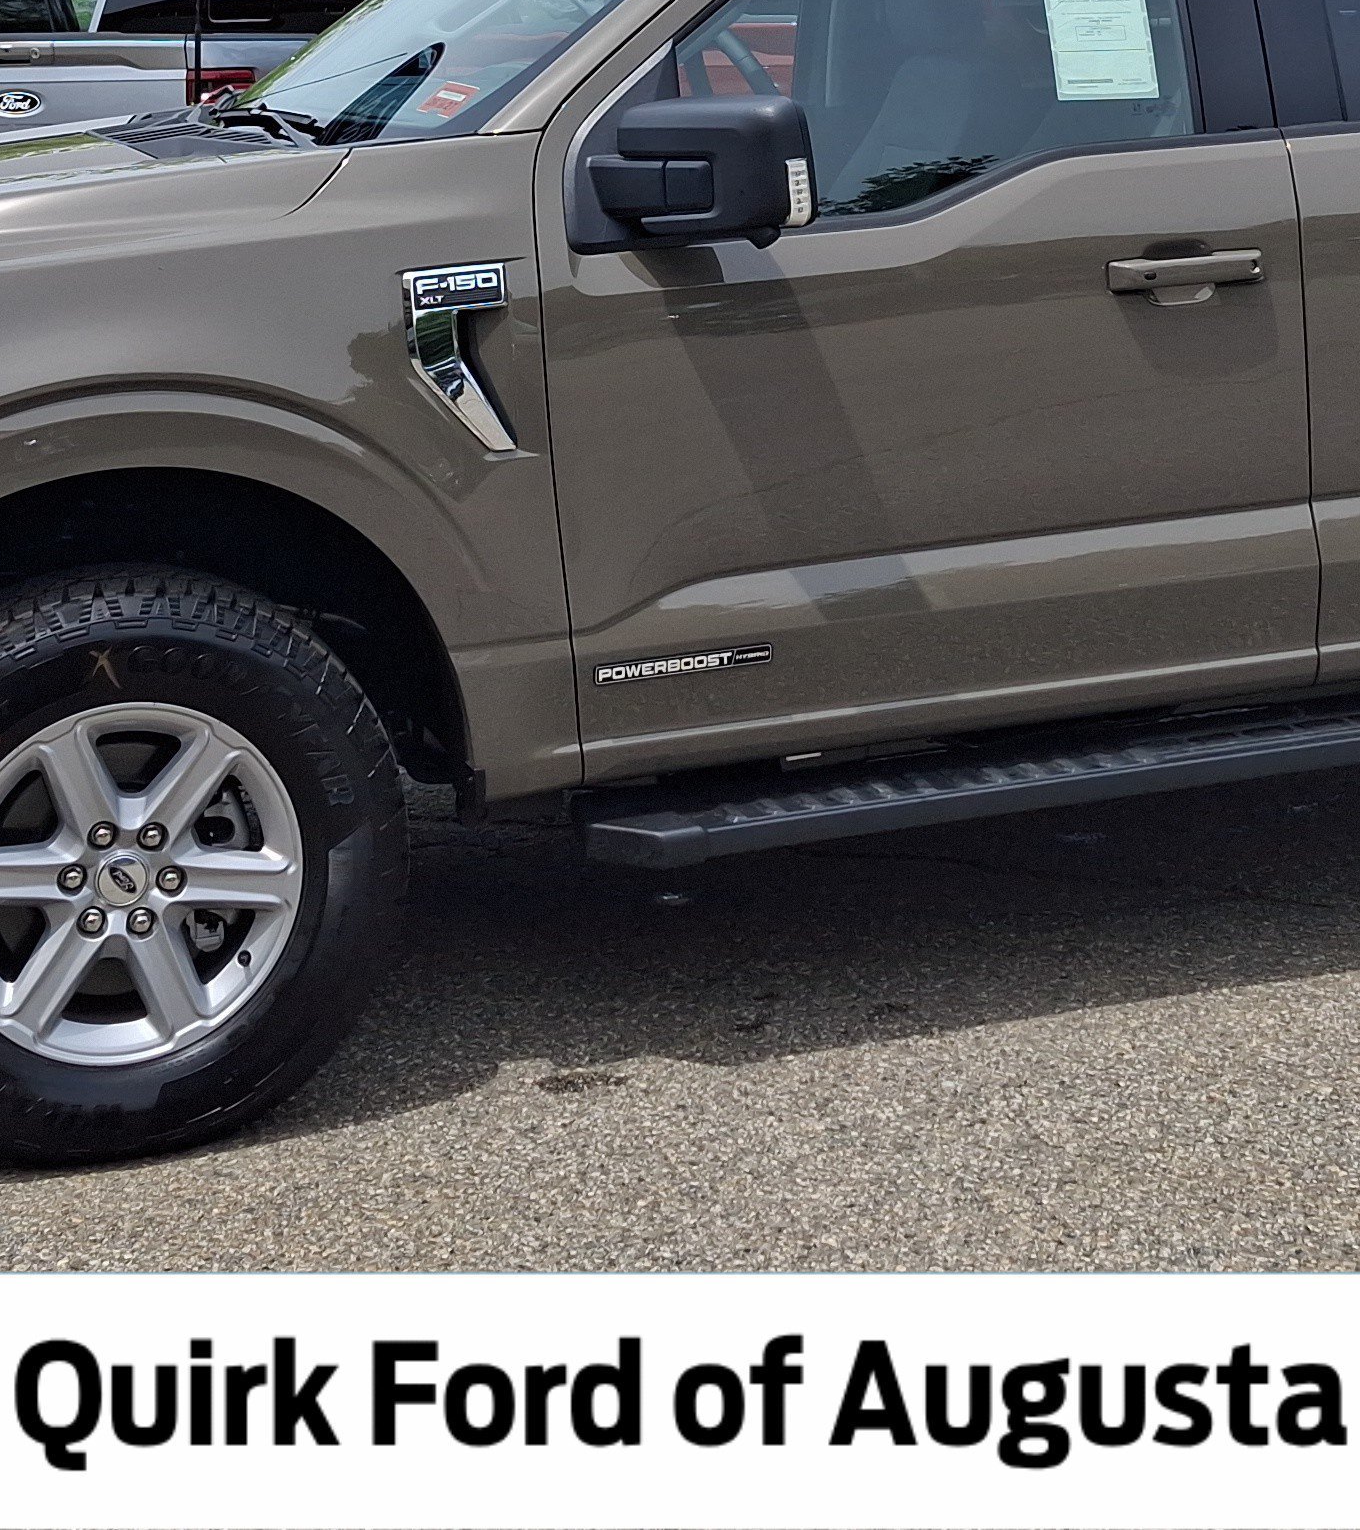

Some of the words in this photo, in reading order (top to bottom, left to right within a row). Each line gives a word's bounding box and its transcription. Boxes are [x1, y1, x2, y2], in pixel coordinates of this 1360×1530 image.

[0, 94, 31, 110] Ford
[415, 271, 498, 295] F-150
[419, 295, 444, 306] XLT
[597, 651, 733, 683] POWERBOOST
